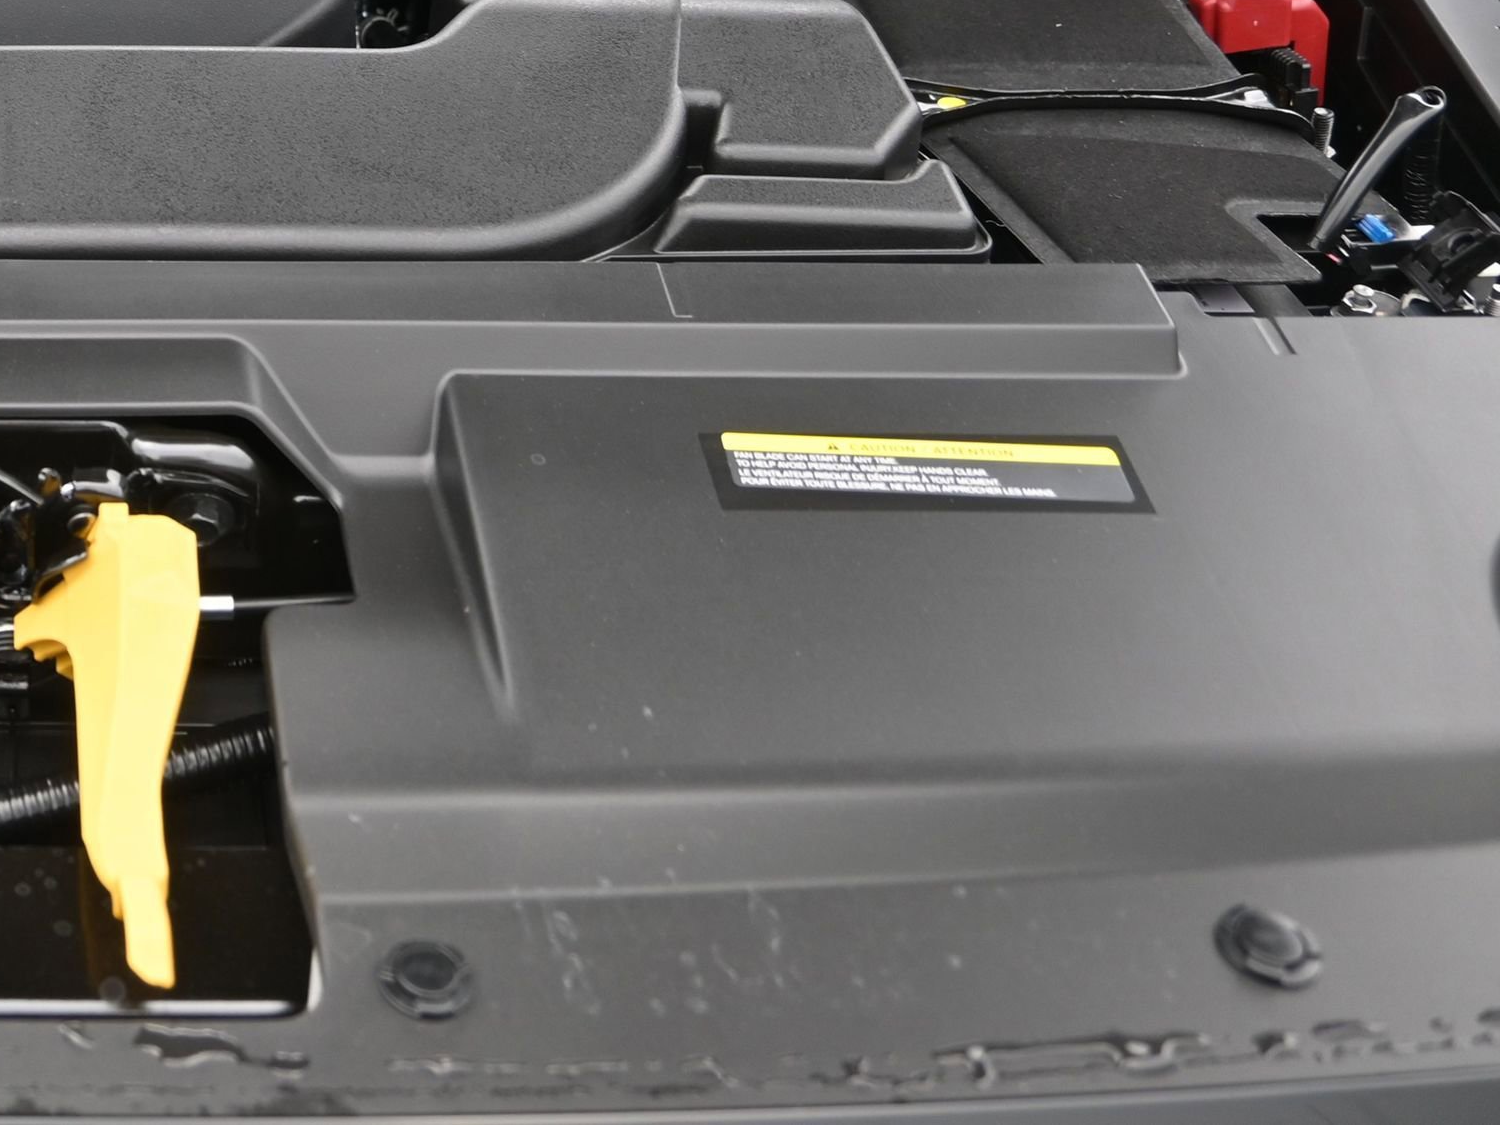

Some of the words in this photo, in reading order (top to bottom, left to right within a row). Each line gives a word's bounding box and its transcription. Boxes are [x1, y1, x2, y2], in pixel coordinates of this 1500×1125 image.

[734, 451, 753, 459] FAN
[754, 452, 786, 460] BLADE
[787, 453, 808, 461] CAN
[809, 454, 839, 462] START
[853, 455, 872, 463] ANY
[849, 443, 916, 453] CAUTION
[933, 446, 1014, 457] ATTENTION
[736, 459, 749, 467] TO
[751, 460, 776, 468] HELP
[777, 461, 806, 469] AVOID
[807, 462, 858, 471] PERSONAL
[919, 467, 953, 475] HANDS
[738, 468, 750, 476] LE
[751, 469, 813, 479] VENTILATEUR
[852, 473, 865, 481] DE
[931, 476, 955, 484] TOUT
[740, 477, 770, 486] POUR
[804, 479, 836, 488] TOUTE
[890, 483, 904, 491] NE
[905, 484, 925, 492] PAS
[1003, 487, 1023, 496] LES
